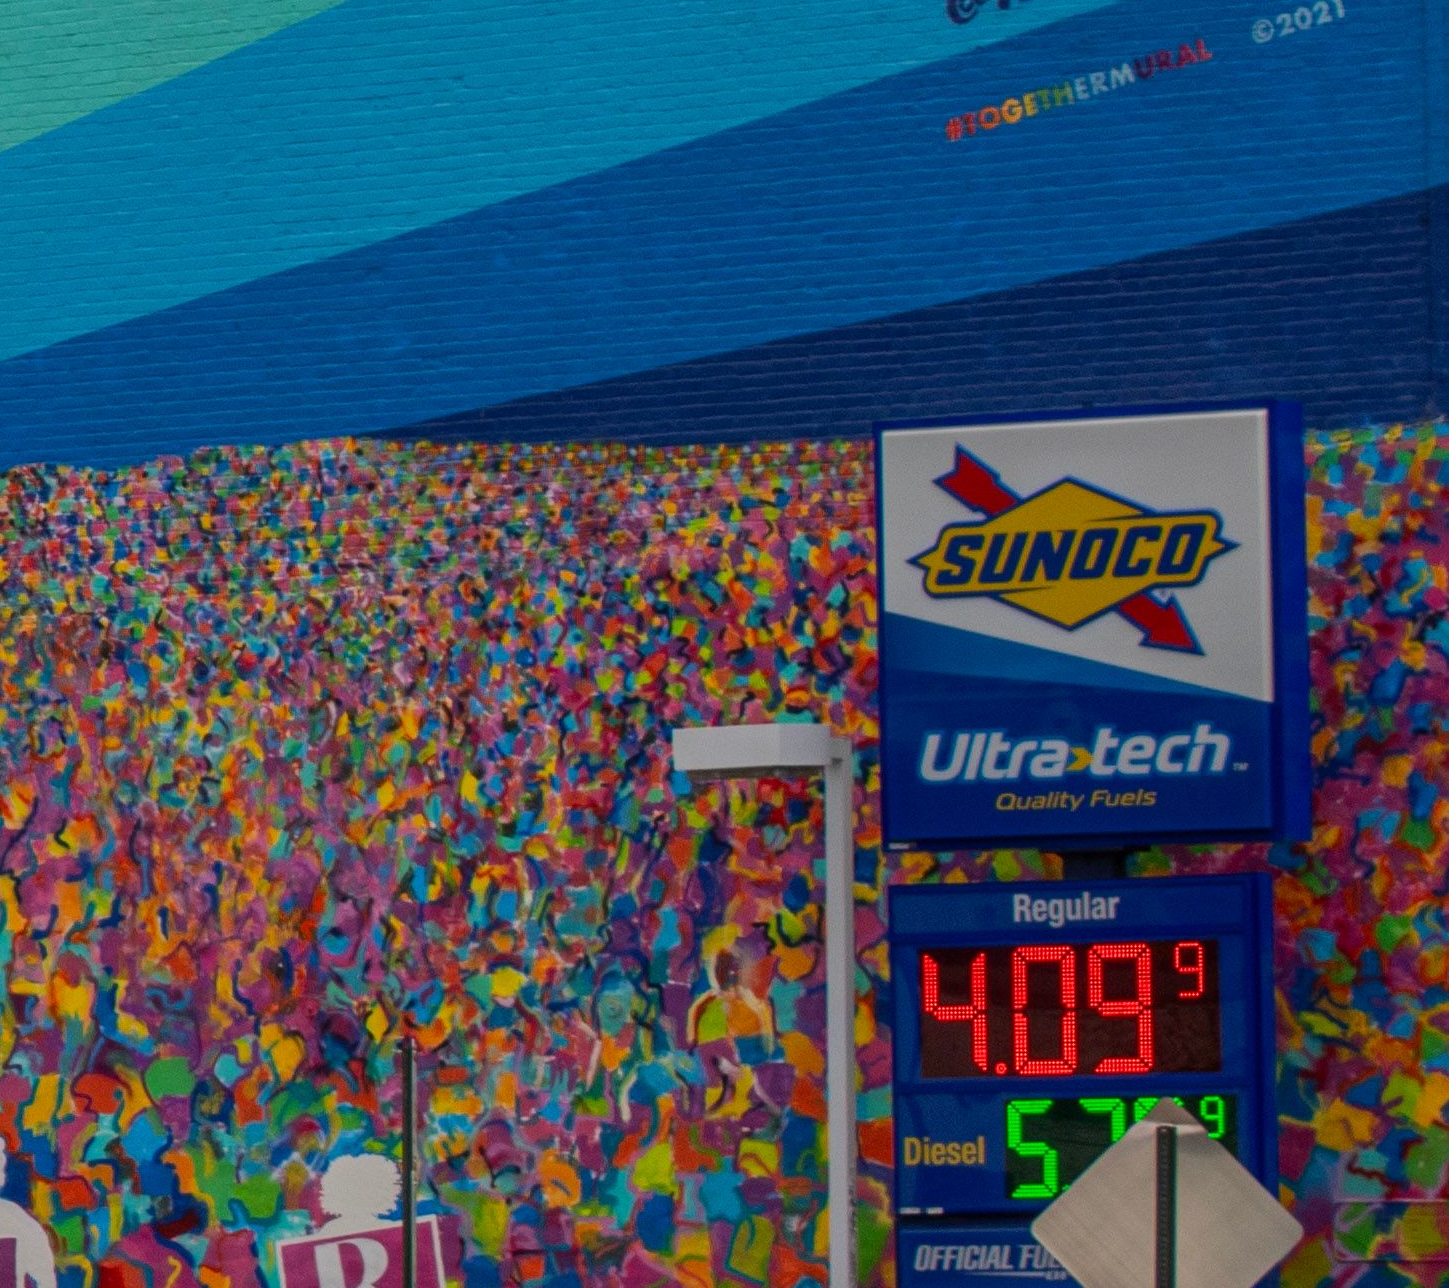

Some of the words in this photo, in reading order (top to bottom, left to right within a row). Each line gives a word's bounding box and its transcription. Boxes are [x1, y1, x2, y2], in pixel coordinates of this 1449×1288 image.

[944, 39, 1213, 142] #TOGETHERMURAL
[934, 522, 1207, 586] SUNOCO
[995, 789, 1084, 812] Quality
[1089, 788, 1158, 808] Fuels
[1012, 891, 1121, 927] Regular
[903, 1136, 986, 1167] Diesel
[913, 1244, 1014, 1272] OFFICIAL
